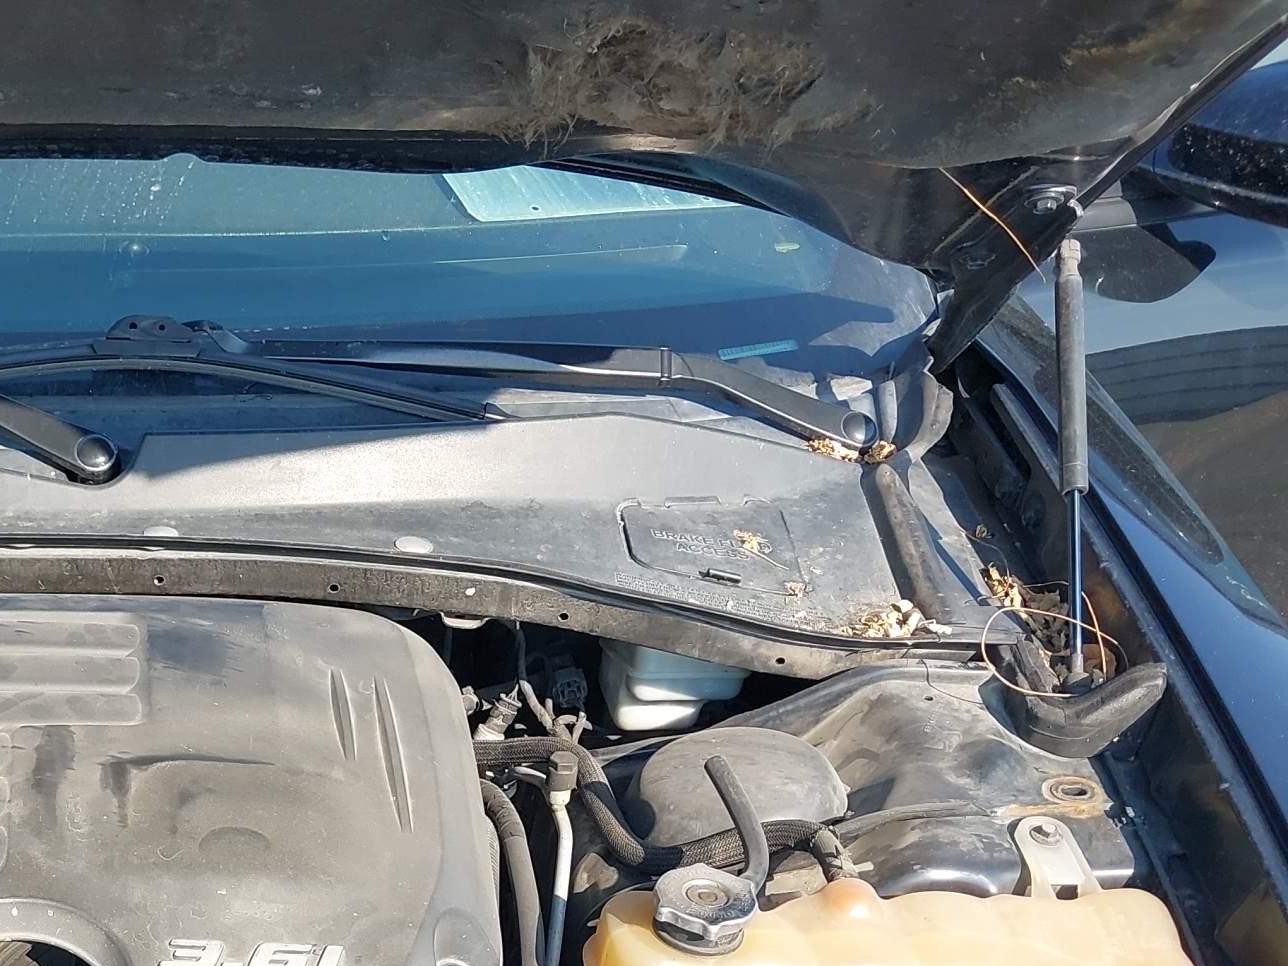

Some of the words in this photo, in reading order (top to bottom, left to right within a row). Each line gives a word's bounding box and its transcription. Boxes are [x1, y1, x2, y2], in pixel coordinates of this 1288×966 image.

[650, 528, 714, 545] BRAKE
[718, 537, 774, 555] FLD
[676, 542, 750, 561] ACCESS
